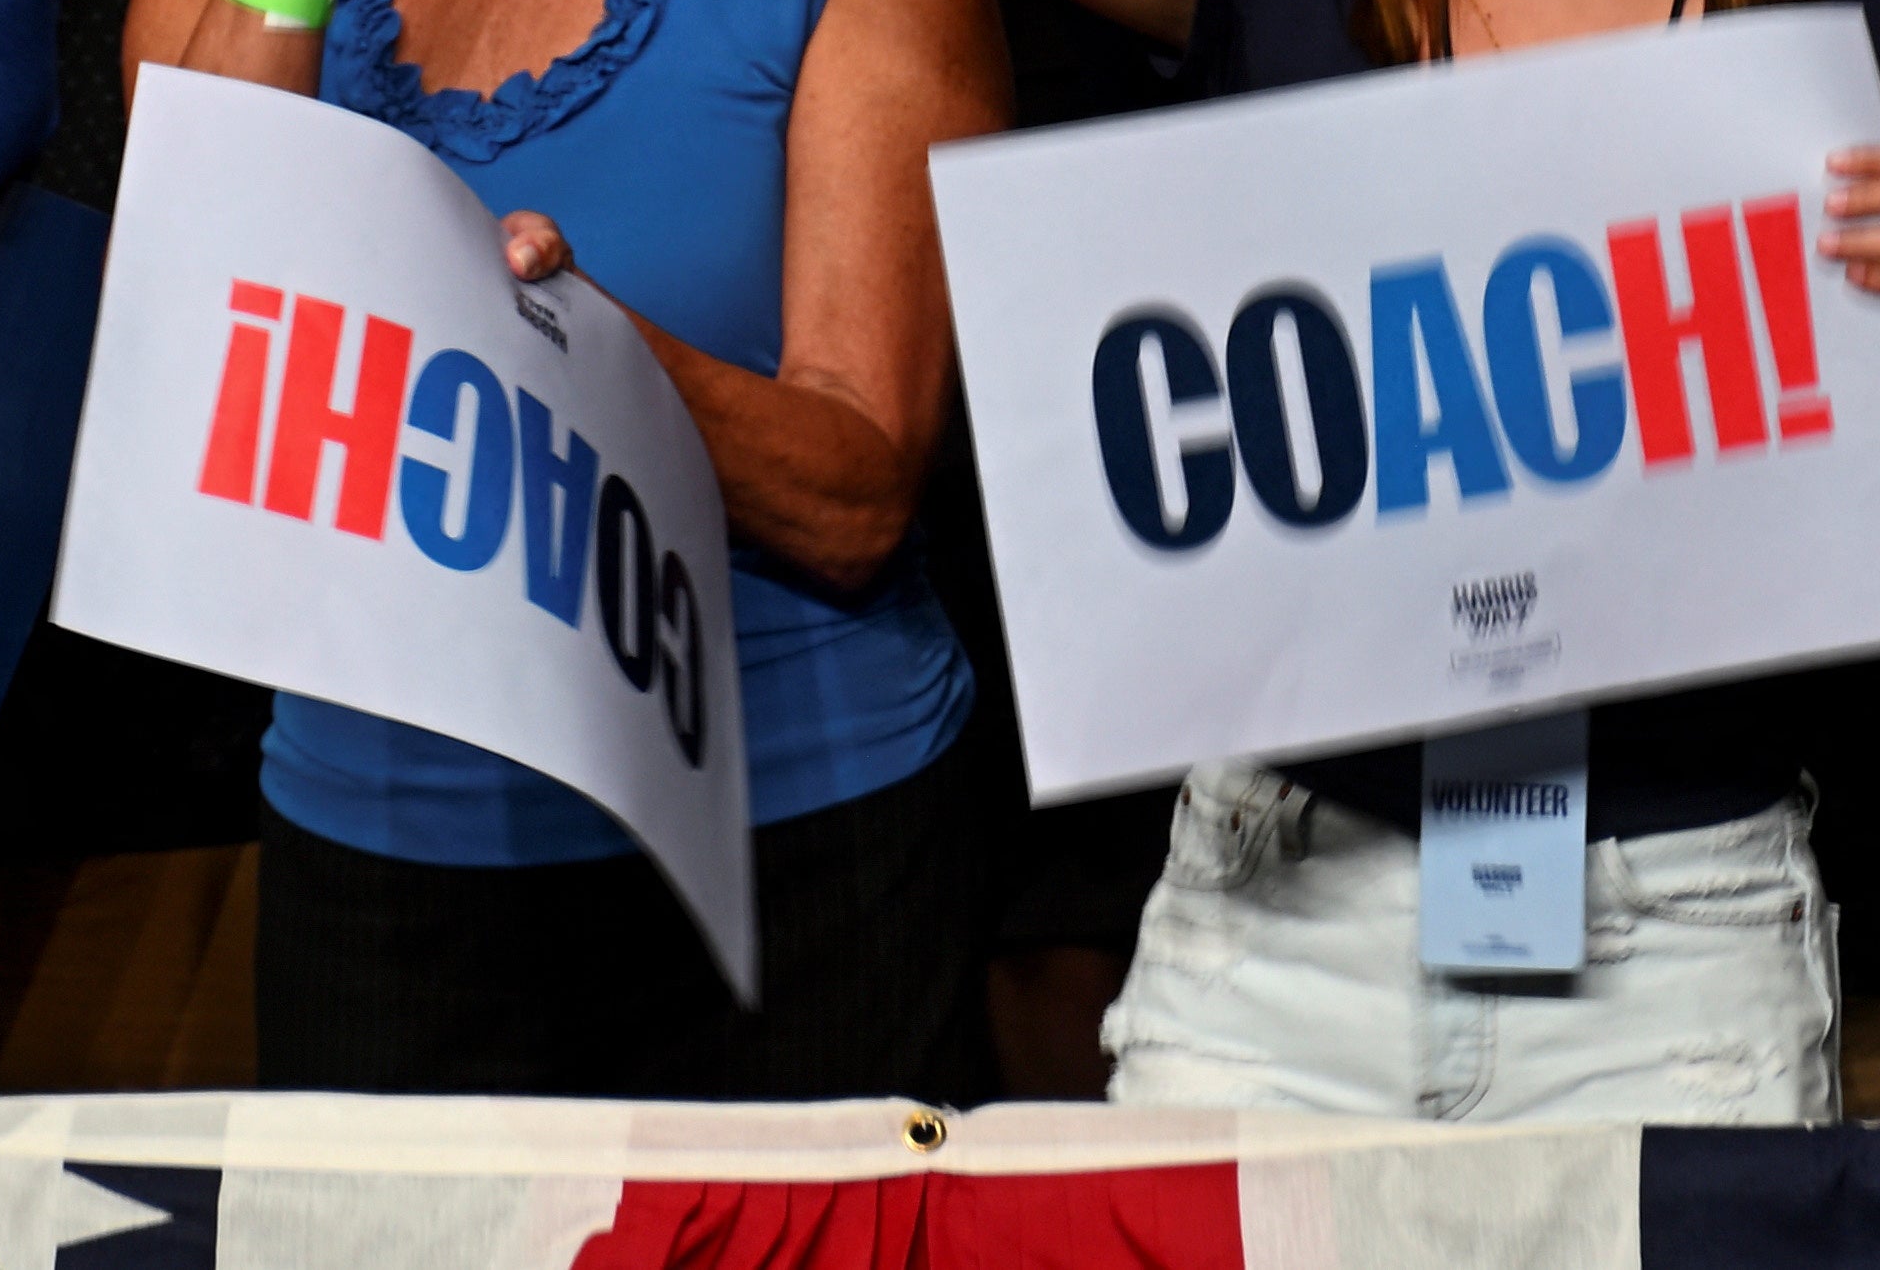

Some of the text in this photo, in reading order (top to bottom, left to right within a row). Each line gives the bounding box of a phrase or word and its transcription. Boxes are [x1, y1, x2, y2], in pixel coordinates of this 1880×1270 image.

[197, 278, 708, 769] COACH!
[1090, 192, 1834, 562] COACH!
[1431, 781, 1569, 819] VOLUNTEER
